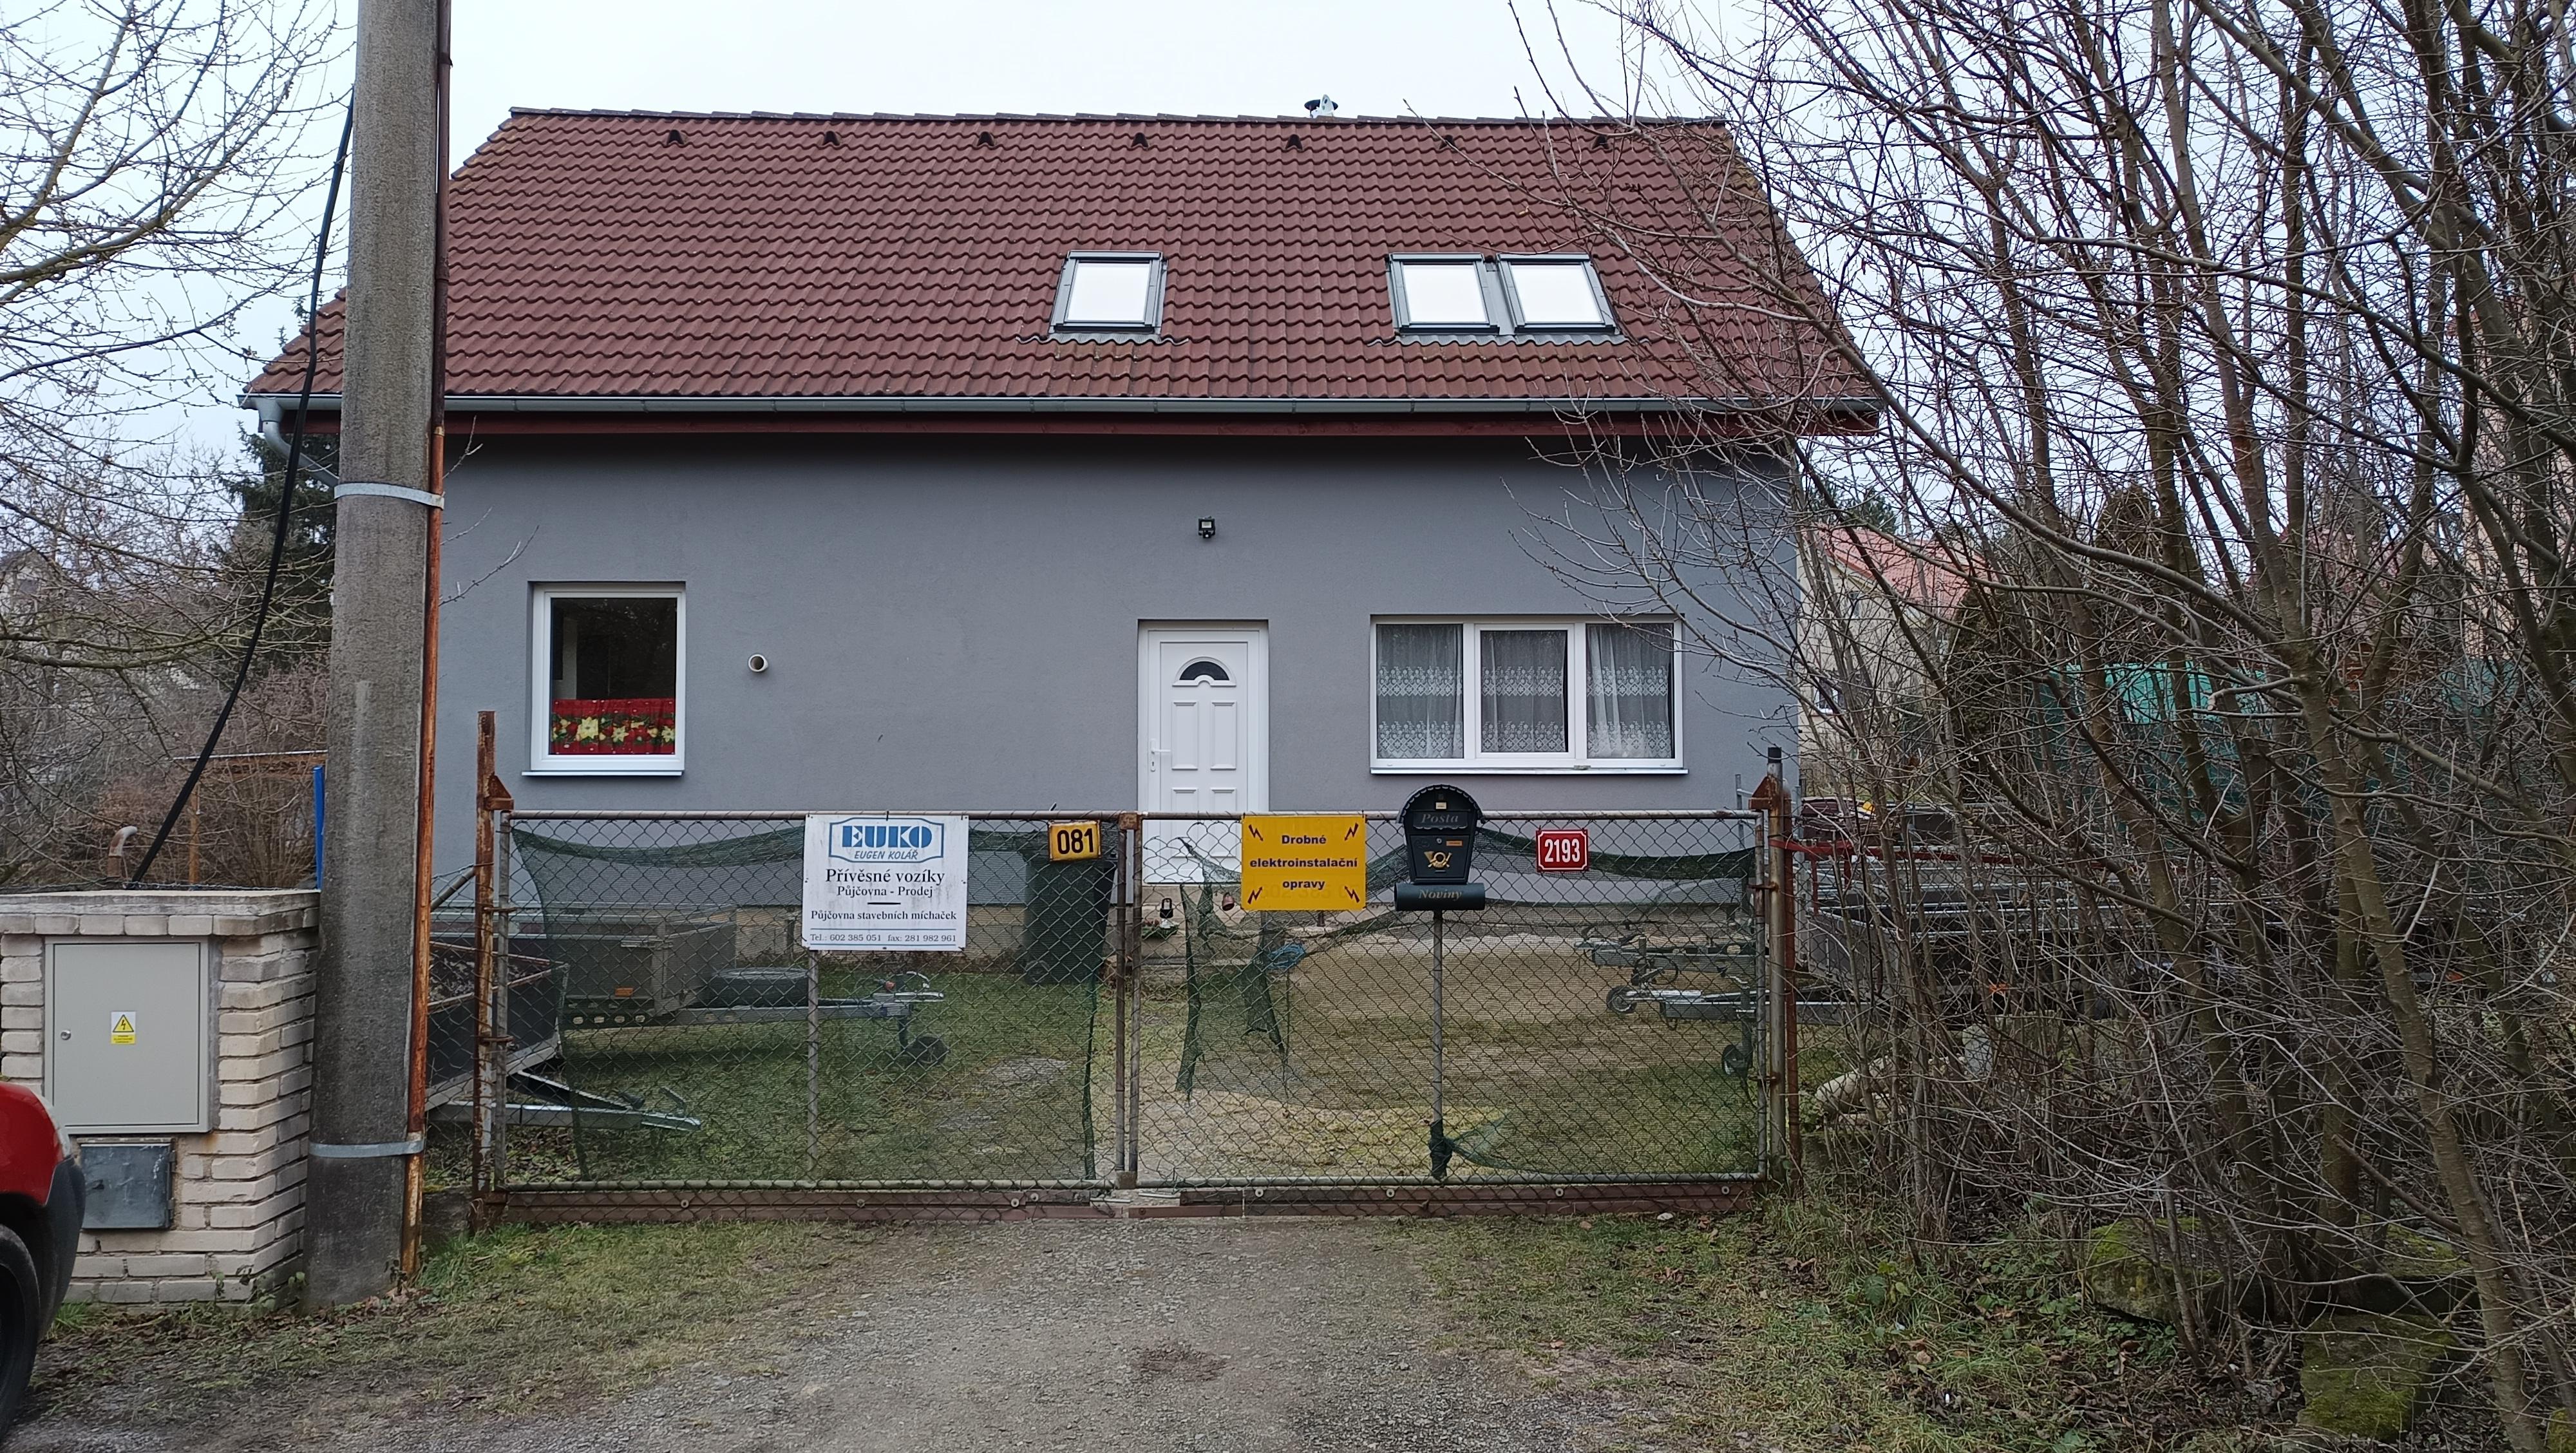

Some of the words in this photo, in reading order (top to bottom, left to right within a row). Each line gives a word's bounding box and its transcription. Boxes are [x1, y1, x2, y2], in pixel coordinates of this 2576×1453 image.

[842, 825, 933, 848] EUKO
[1057, 828, 1094, 855] 081
[1282, 835, 1327, 844] Drobné
[854, 851, 885, 859] EUGEN
[887, 849, 919, 860] KOLÁŘ
[1544, 839, 1580, 862] 2193
[1249, 858, 1358, 868] elektroinstalační
[825, 868, 891, 882] Přívěsné
[895, 869, 945, 886] vozíky
[1282, 880, 1325, 890] opravy
[837, 885, 887, 898] Půjčovna
[897, 886, 933, 898] Prodej
[1418, 889, 1463, 901] Noviny
[811, 909, 855, 920] Půjčovna
[857, 910, 908, 920] stavebních
[911, 910, 957, 920] míchaček
[887, 934, 902, 942] fax:
